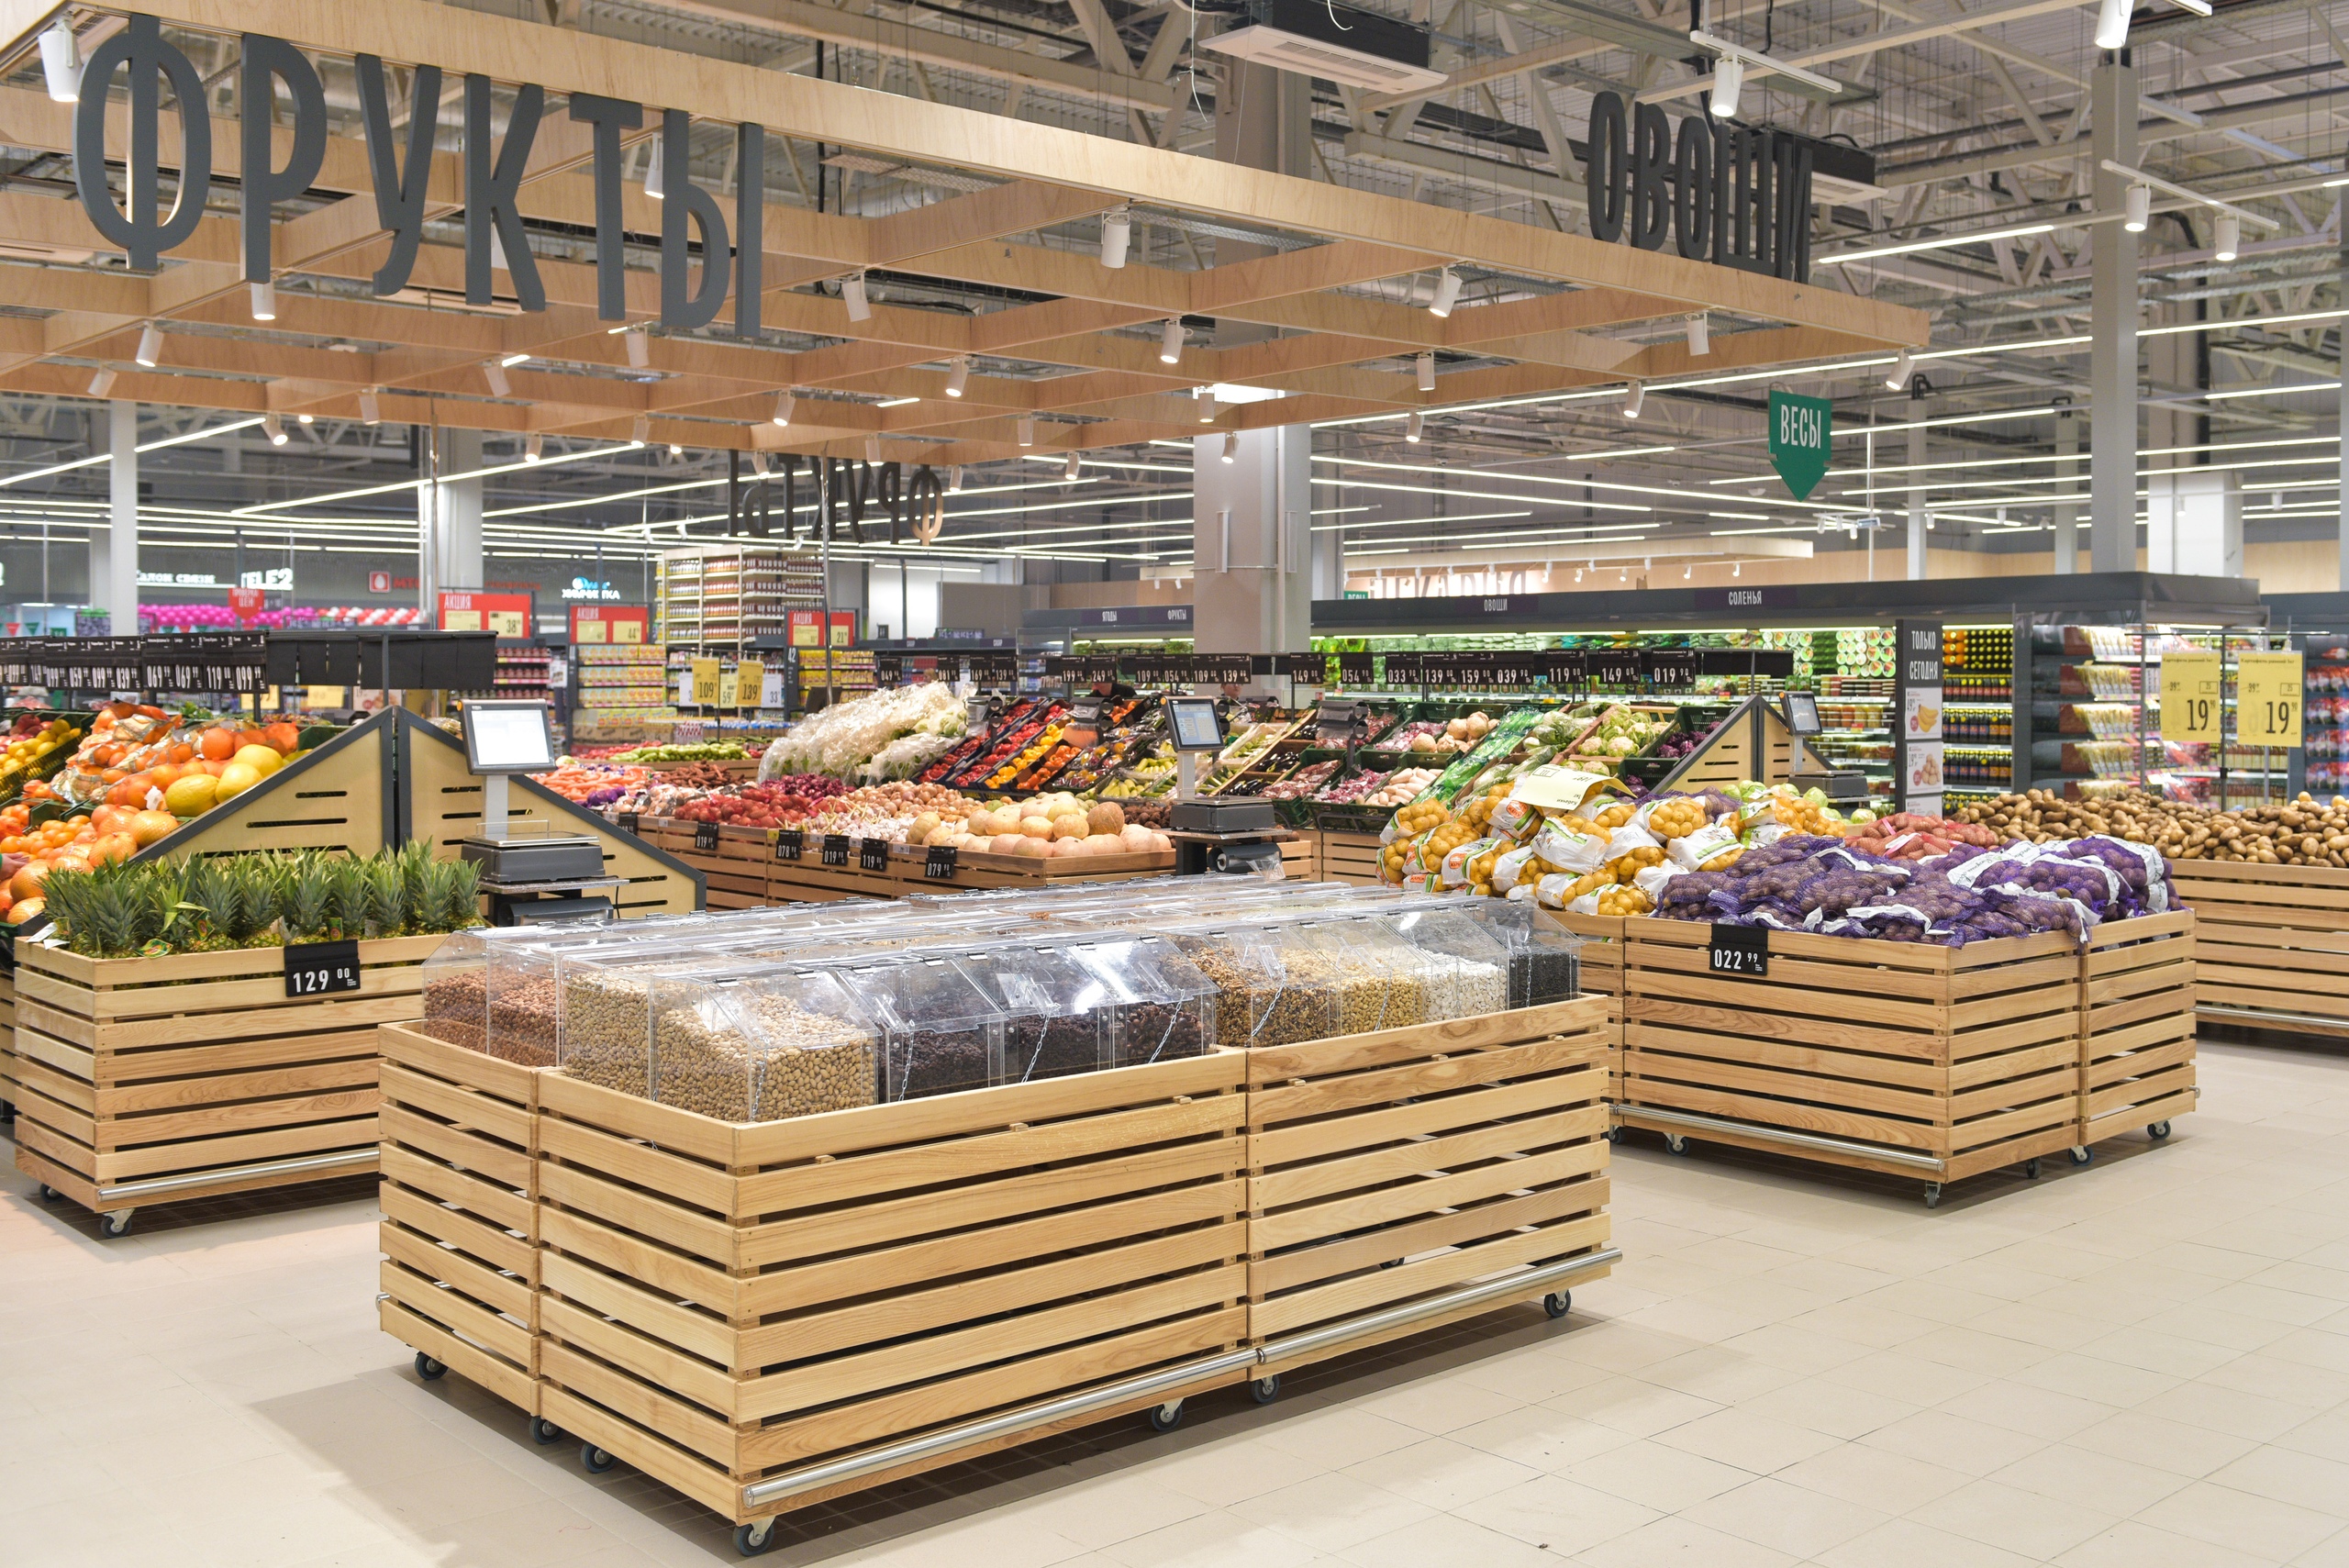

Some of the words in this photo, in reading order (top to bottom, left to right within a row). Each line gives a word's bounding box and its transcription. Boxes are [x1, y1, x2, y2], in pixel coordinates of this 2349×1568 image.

[72, 14, 763, 339] ФРУКТЫ
[1587, 91, 1813, 285] ОВОЩИ
[1780, 404, 1821, 449] ВЕСЫ
[443, 594, 472, 610] АКЦИЯ
[1484, 598, 1508, 612] ОВОЩИ
[1728, 590, 1762, 606] СОЛЕНЬЯ
[793, 612, 812, 625] АКЦИЯ
[1102, 610, 1118, 622] ЯГОДЫ
[1167, 609, 1187, 620] ФРУКТЫ
[506, 618, 517, 634] 38
[628, 628, 637, 639] 44
[836, 631, 844, 643] 21
[1911, 630, 1936, 651] ТОЛЬКО
[787, 647, 796, 663] 42
[116, 666, 130, 689] 039
[147, 665, 163, 688] 069
[175, 664, 191, 689] 069
[206, 664, 222, 690] 119
[236, 665, 252, 691] 099
[880, 669, 893, 681] 049
[971, 669, 983, 681] 169
[996, 669, 1008, 681] 139
[1063, 670, 1075, 683] 199
[1092, 670, 1106, 683] 249
[1137, 670, 1152, 683] 109
[1163, 670, 1179, 683] 054
[1194, 670, 1208, 683] 109
[1222, 670, 1238, 683] 139
[1293, 669, 1308, 683] 149
[1341, 668, 1360, 683] 054
[1387, 669, 1407, 683] 033
[1425, 669, 1443, 683] 139
[1461, 669, 1479, 684] 159
[1497, 669, 1517, 684] 039
[1550, 667, 1570, 683] 119
[1573, 668, 1581, 676] 00
[1602, 667, 1622, 683] 149
[1626, 667, 1634, 675] 00
[1653, 667, 1676, 683] 019
[1680, 668, 1689, 676] 90
[1909, 661, 1938, 680] СЕГОДНЯ
[698, 682, 715, 698] 109
[741, 684, 758, 700] 139
[770, 691, 778, 704] 33
[2187, 698, 2209, 731] 19
[2266, 701, 2290, 735] 19
[2291, 702, 2298, 711] 90
[696, 836, 707, 848] 019
[778, 845, 790, 858] 078
[824, 850, 837, 863] 019
[863, 854, 875, 869] 119
[927, 862, 941, 877] 079
[1714, 949, 1742, 970] 022
[1747, 952, 1758, 963] 99
[293, 970, 328, 993] 129
[337, 967, 350, 979] 00
